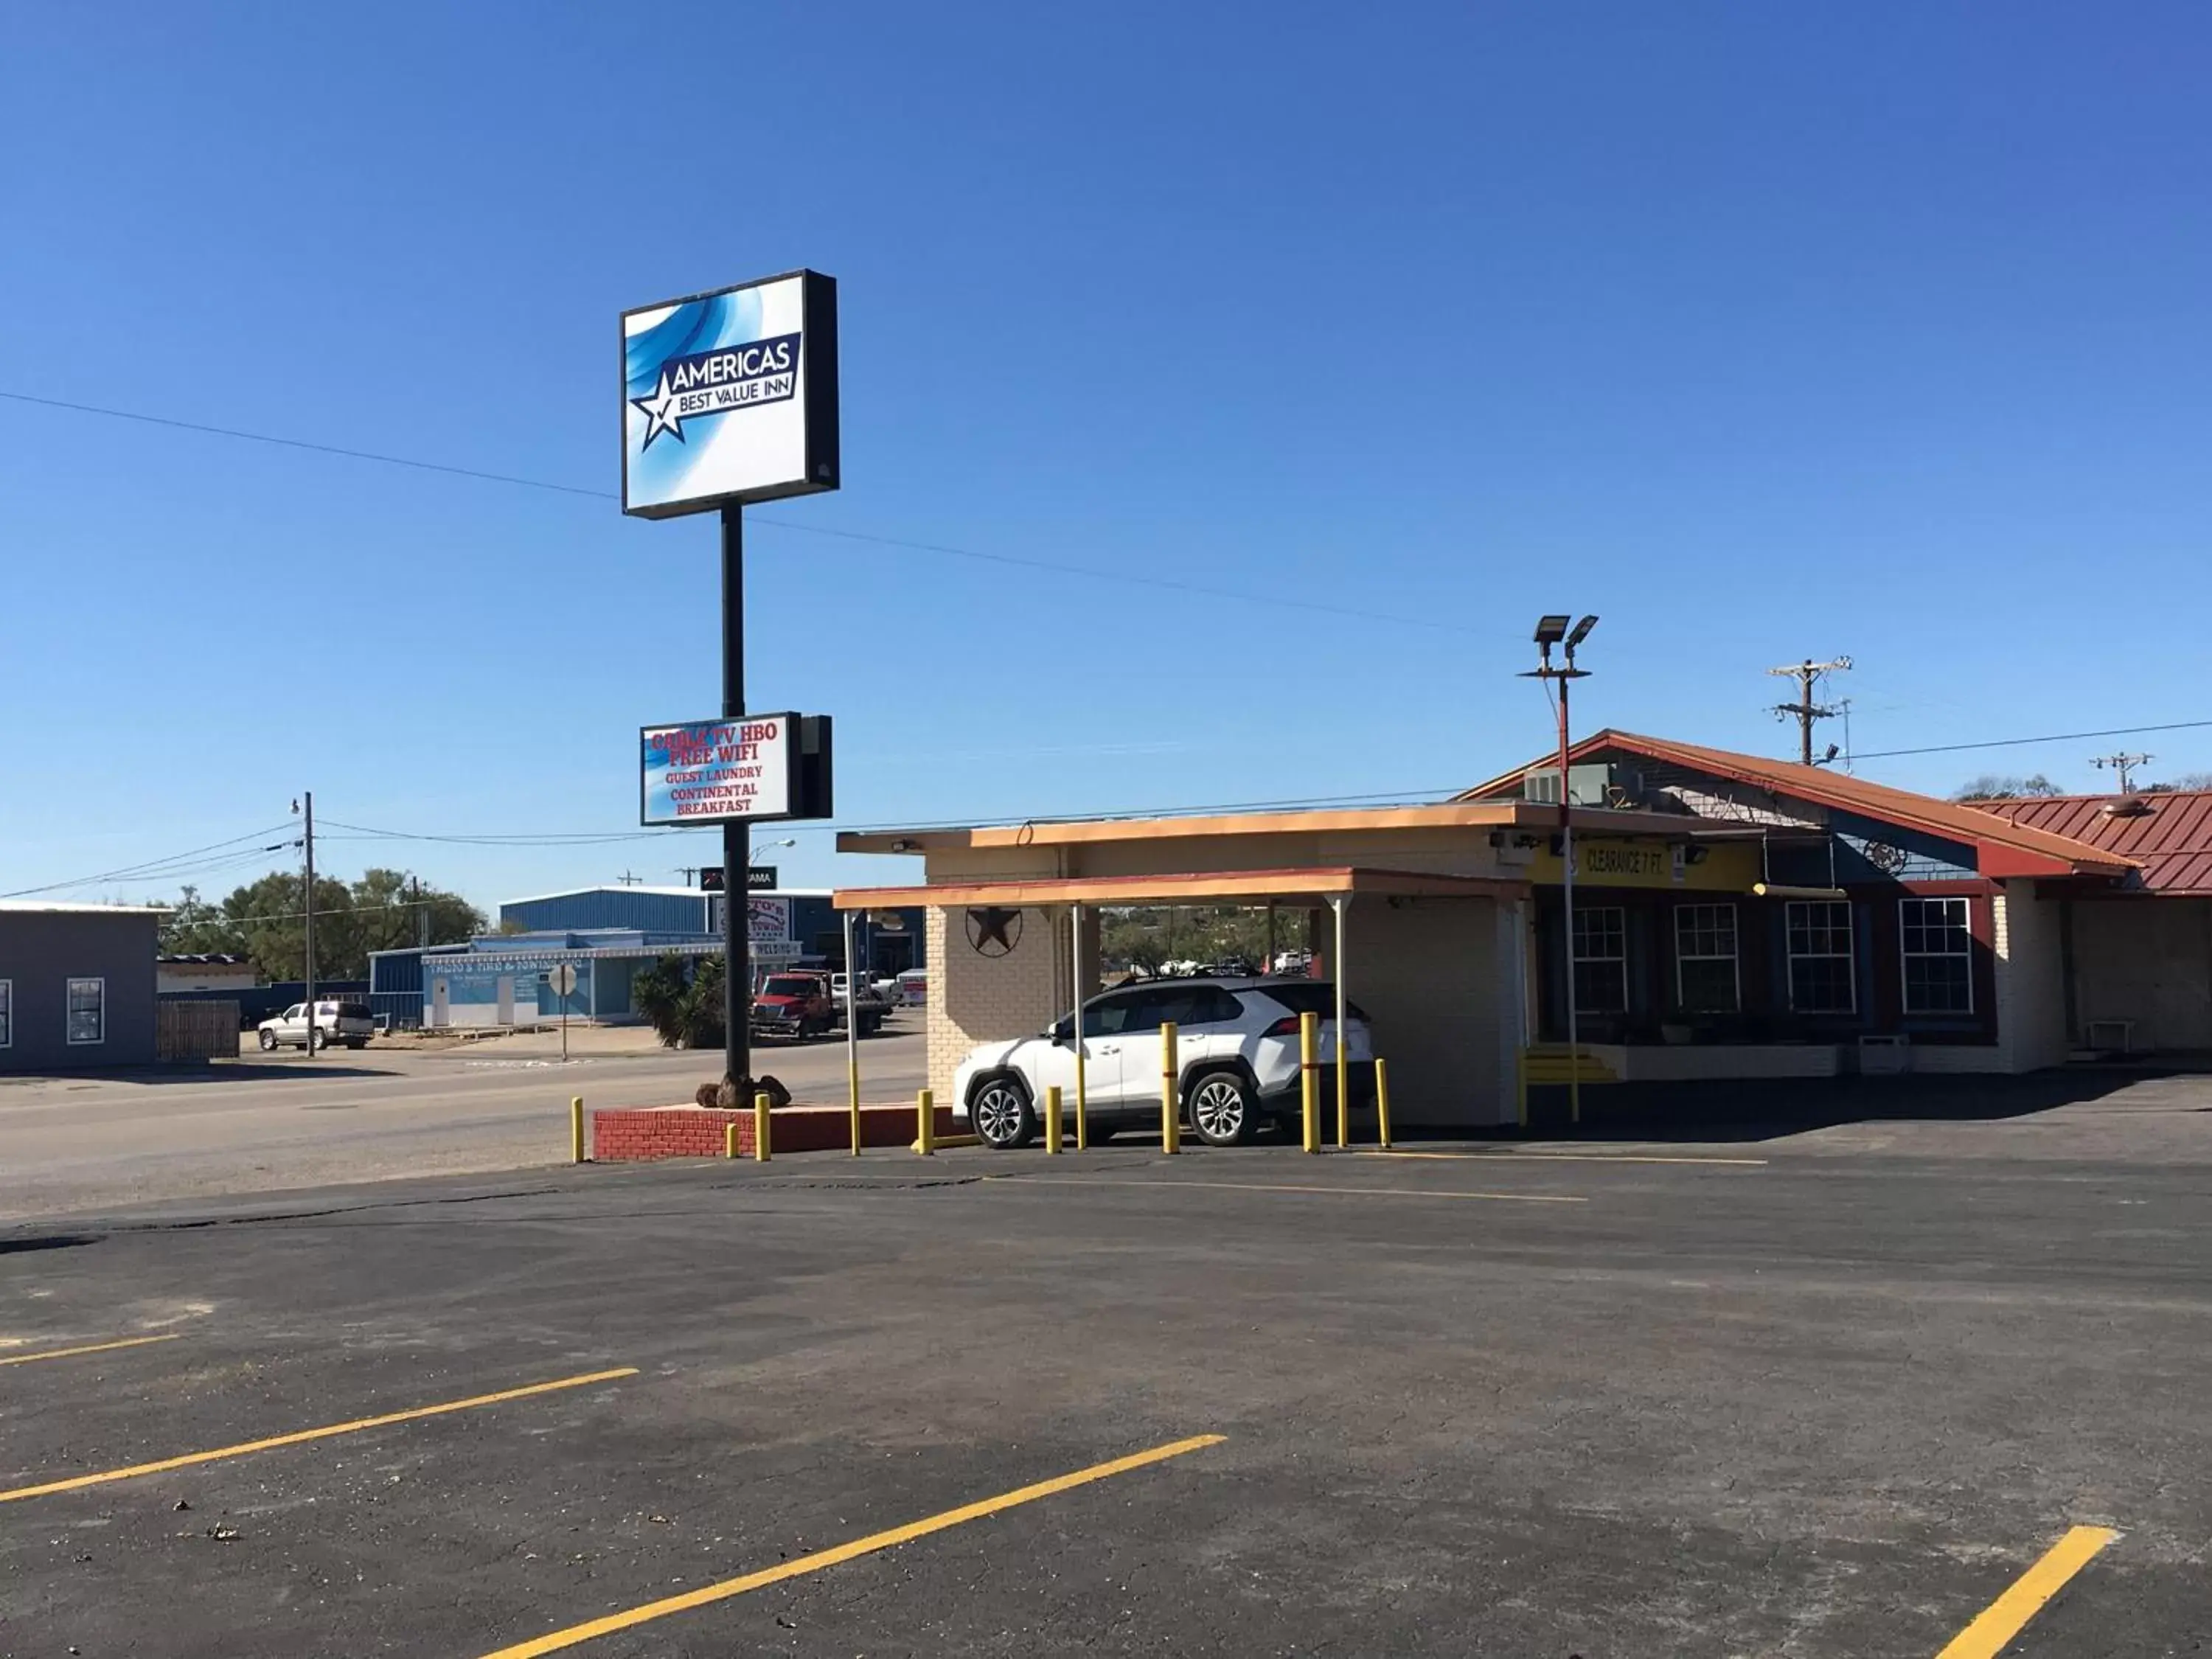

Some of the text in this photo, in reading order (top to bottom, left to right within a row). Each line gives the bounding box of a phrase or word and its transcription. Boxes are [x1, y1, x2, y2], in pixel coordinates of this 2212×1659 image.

[672, 341, 790, 392] AMERICAS
[680, 377, 789, 413] BEST VALUE INN
[652, 723, 777, 751] CABLE TV HBO
[669, 743, 759, 767] FREE WIFI
[666, 765, 762, 785] GUEST LAUNDRY
[671, 783, 758, 801] CONTINENTAL
[677, 799, 751, 816] BREAKFAST
[1587, 849, 1641, 874] CLEARANCE
[1643, 852, 1648, 873] 7
